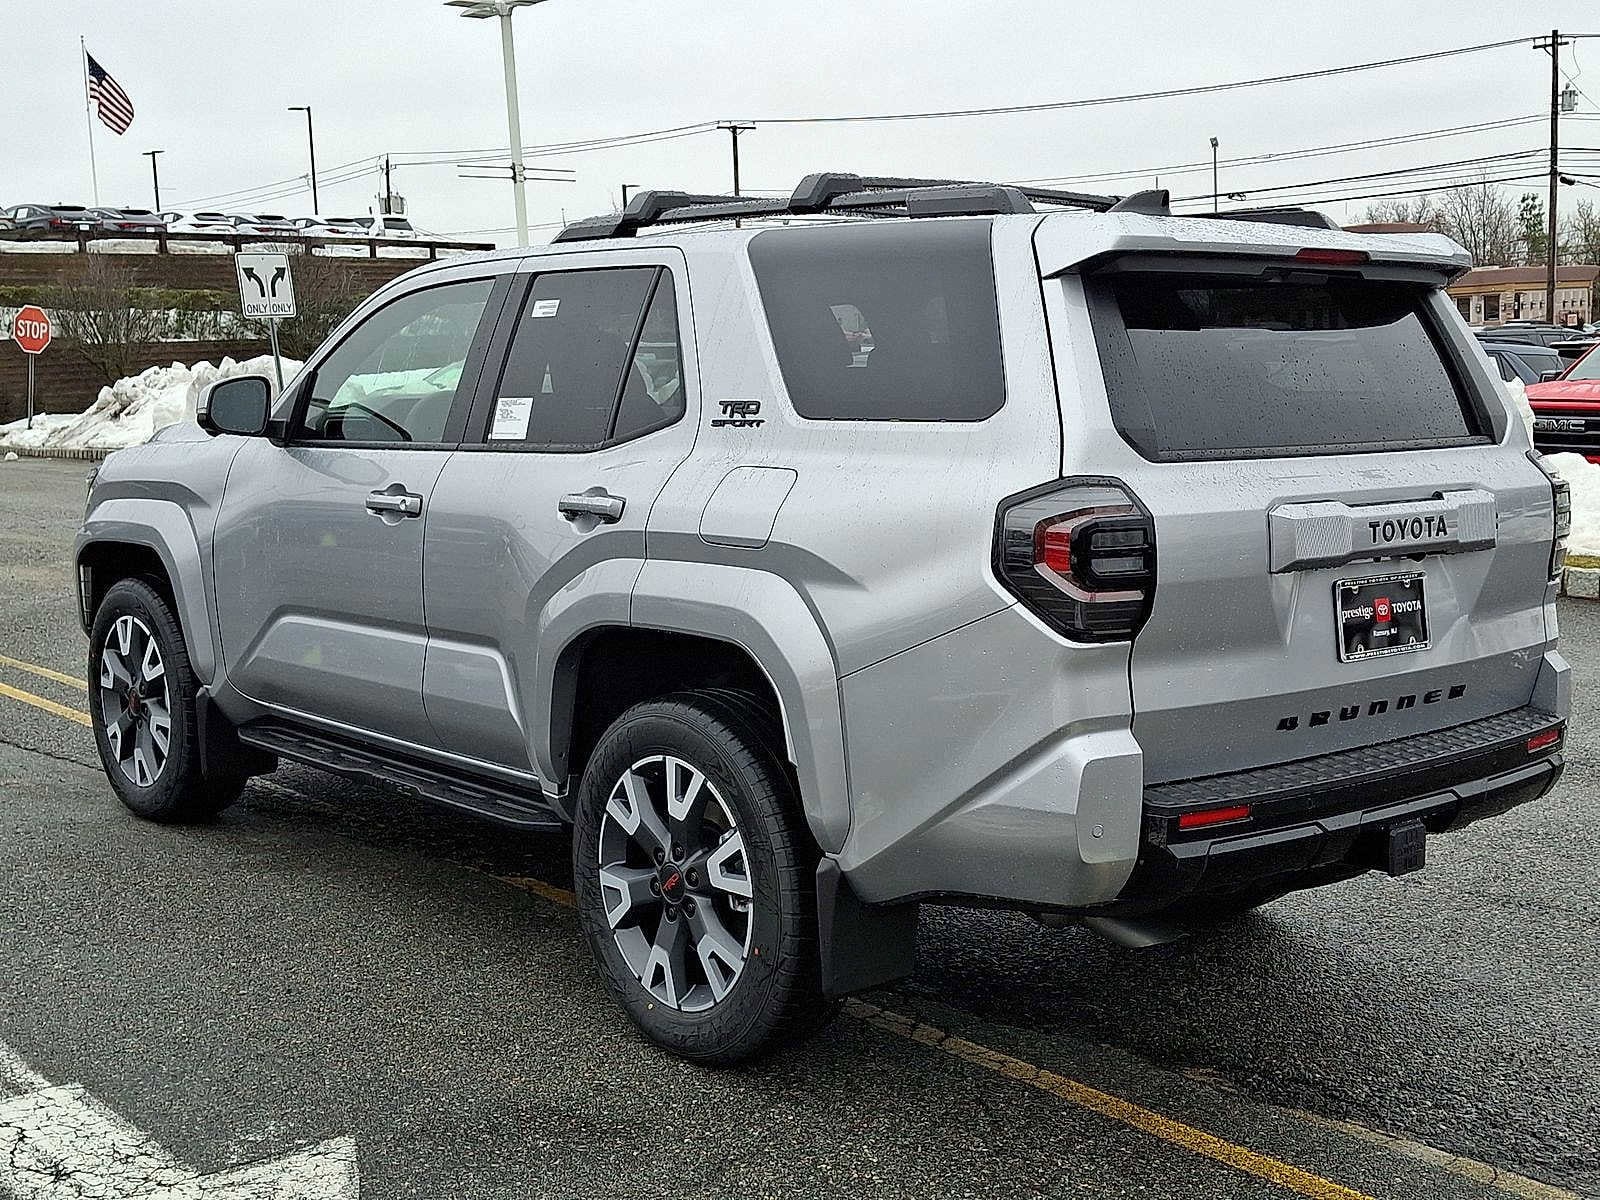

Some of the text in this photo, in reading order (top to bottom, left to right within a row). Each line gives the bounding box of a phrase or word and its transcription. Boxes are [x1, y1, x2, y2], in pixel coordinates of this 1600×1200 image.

[247, 303, 291, 313] ONLY ONLY
[17, 319, 48, 339] STOP
[719, 400, 761, 418] TRD
[711, 419, 766, 428] SPORT
[1534, 419, 1585, 431] GMC
[1368, 514, 1448, 544] TOYOTA
[1342, 599, 1422, 623] prestige TOYOTA
[1276, 684, 1467, 731] 4RUNNER
